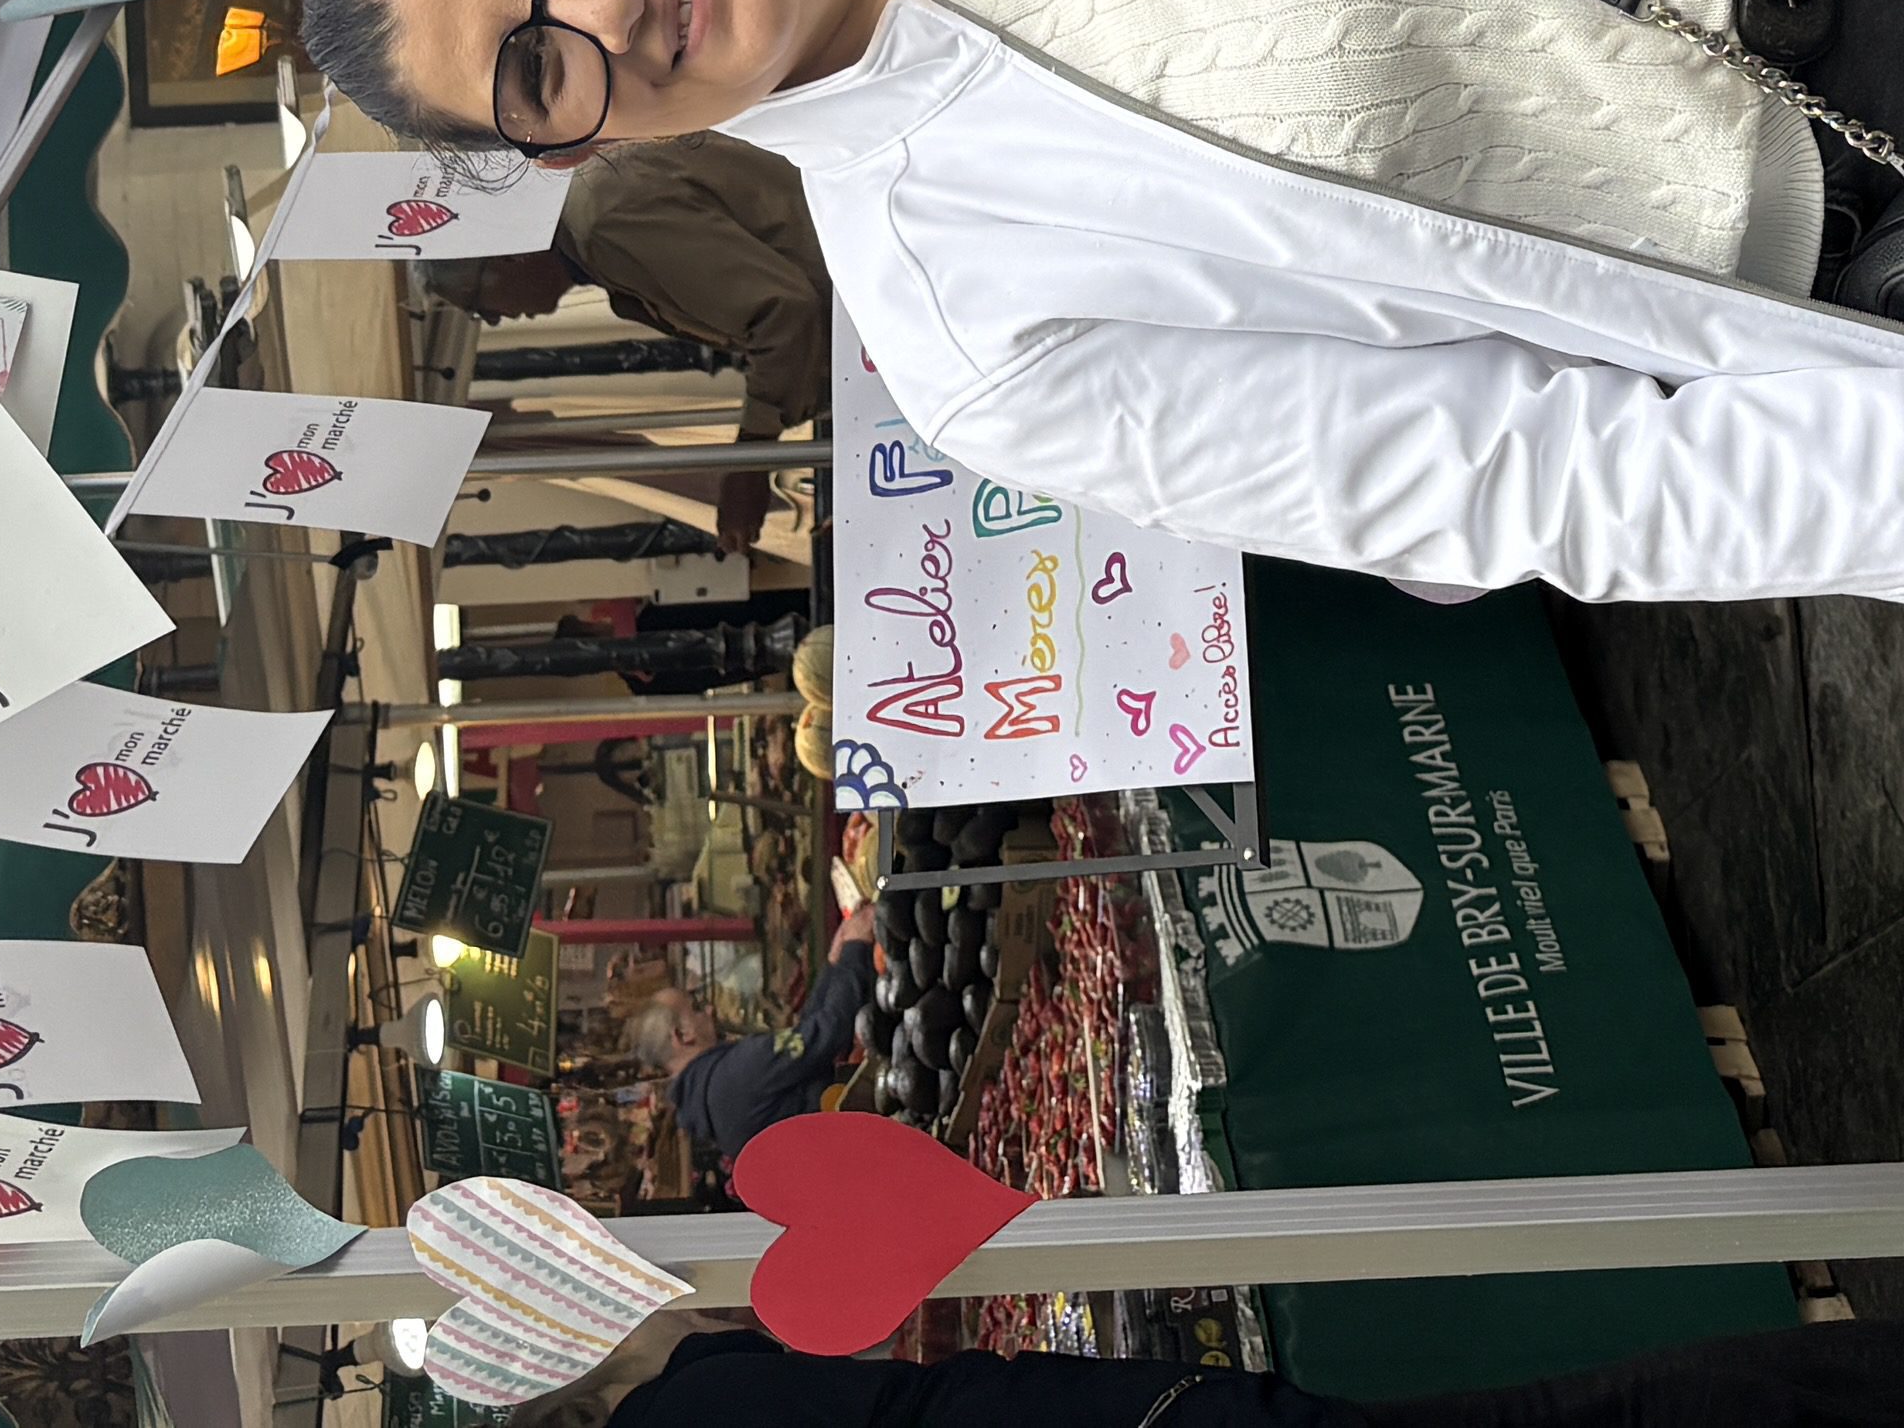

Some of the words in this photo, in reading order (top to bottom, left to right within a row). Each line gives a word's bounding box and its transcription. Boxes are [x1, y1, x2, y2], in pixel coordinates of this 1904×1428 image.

[295, 422, 321, 449] mon
[318, 399, 359, 452] marché
[864, 518, 965, 738] Atelier
[983, 549, 1063, 740] Mères
[1207, 664, 1241, 748] Accès
[113, 731, 146, 763] mon
[138, 706, 193, 767] marché
[1386, 681, 1514, 948] BRY-SUR-MARNE
[1484, 789, 1524, 836] Paris
[1502, 838, 1541, 876] que
[1509, 878, 1548, 915] viel
[1524, 916, 1568, 973] Moult
[1467, 951, 1531, 996] DE
[1483, 998, 1562, 1108] VILLE
[11, 1127, 66, 1180] marché
